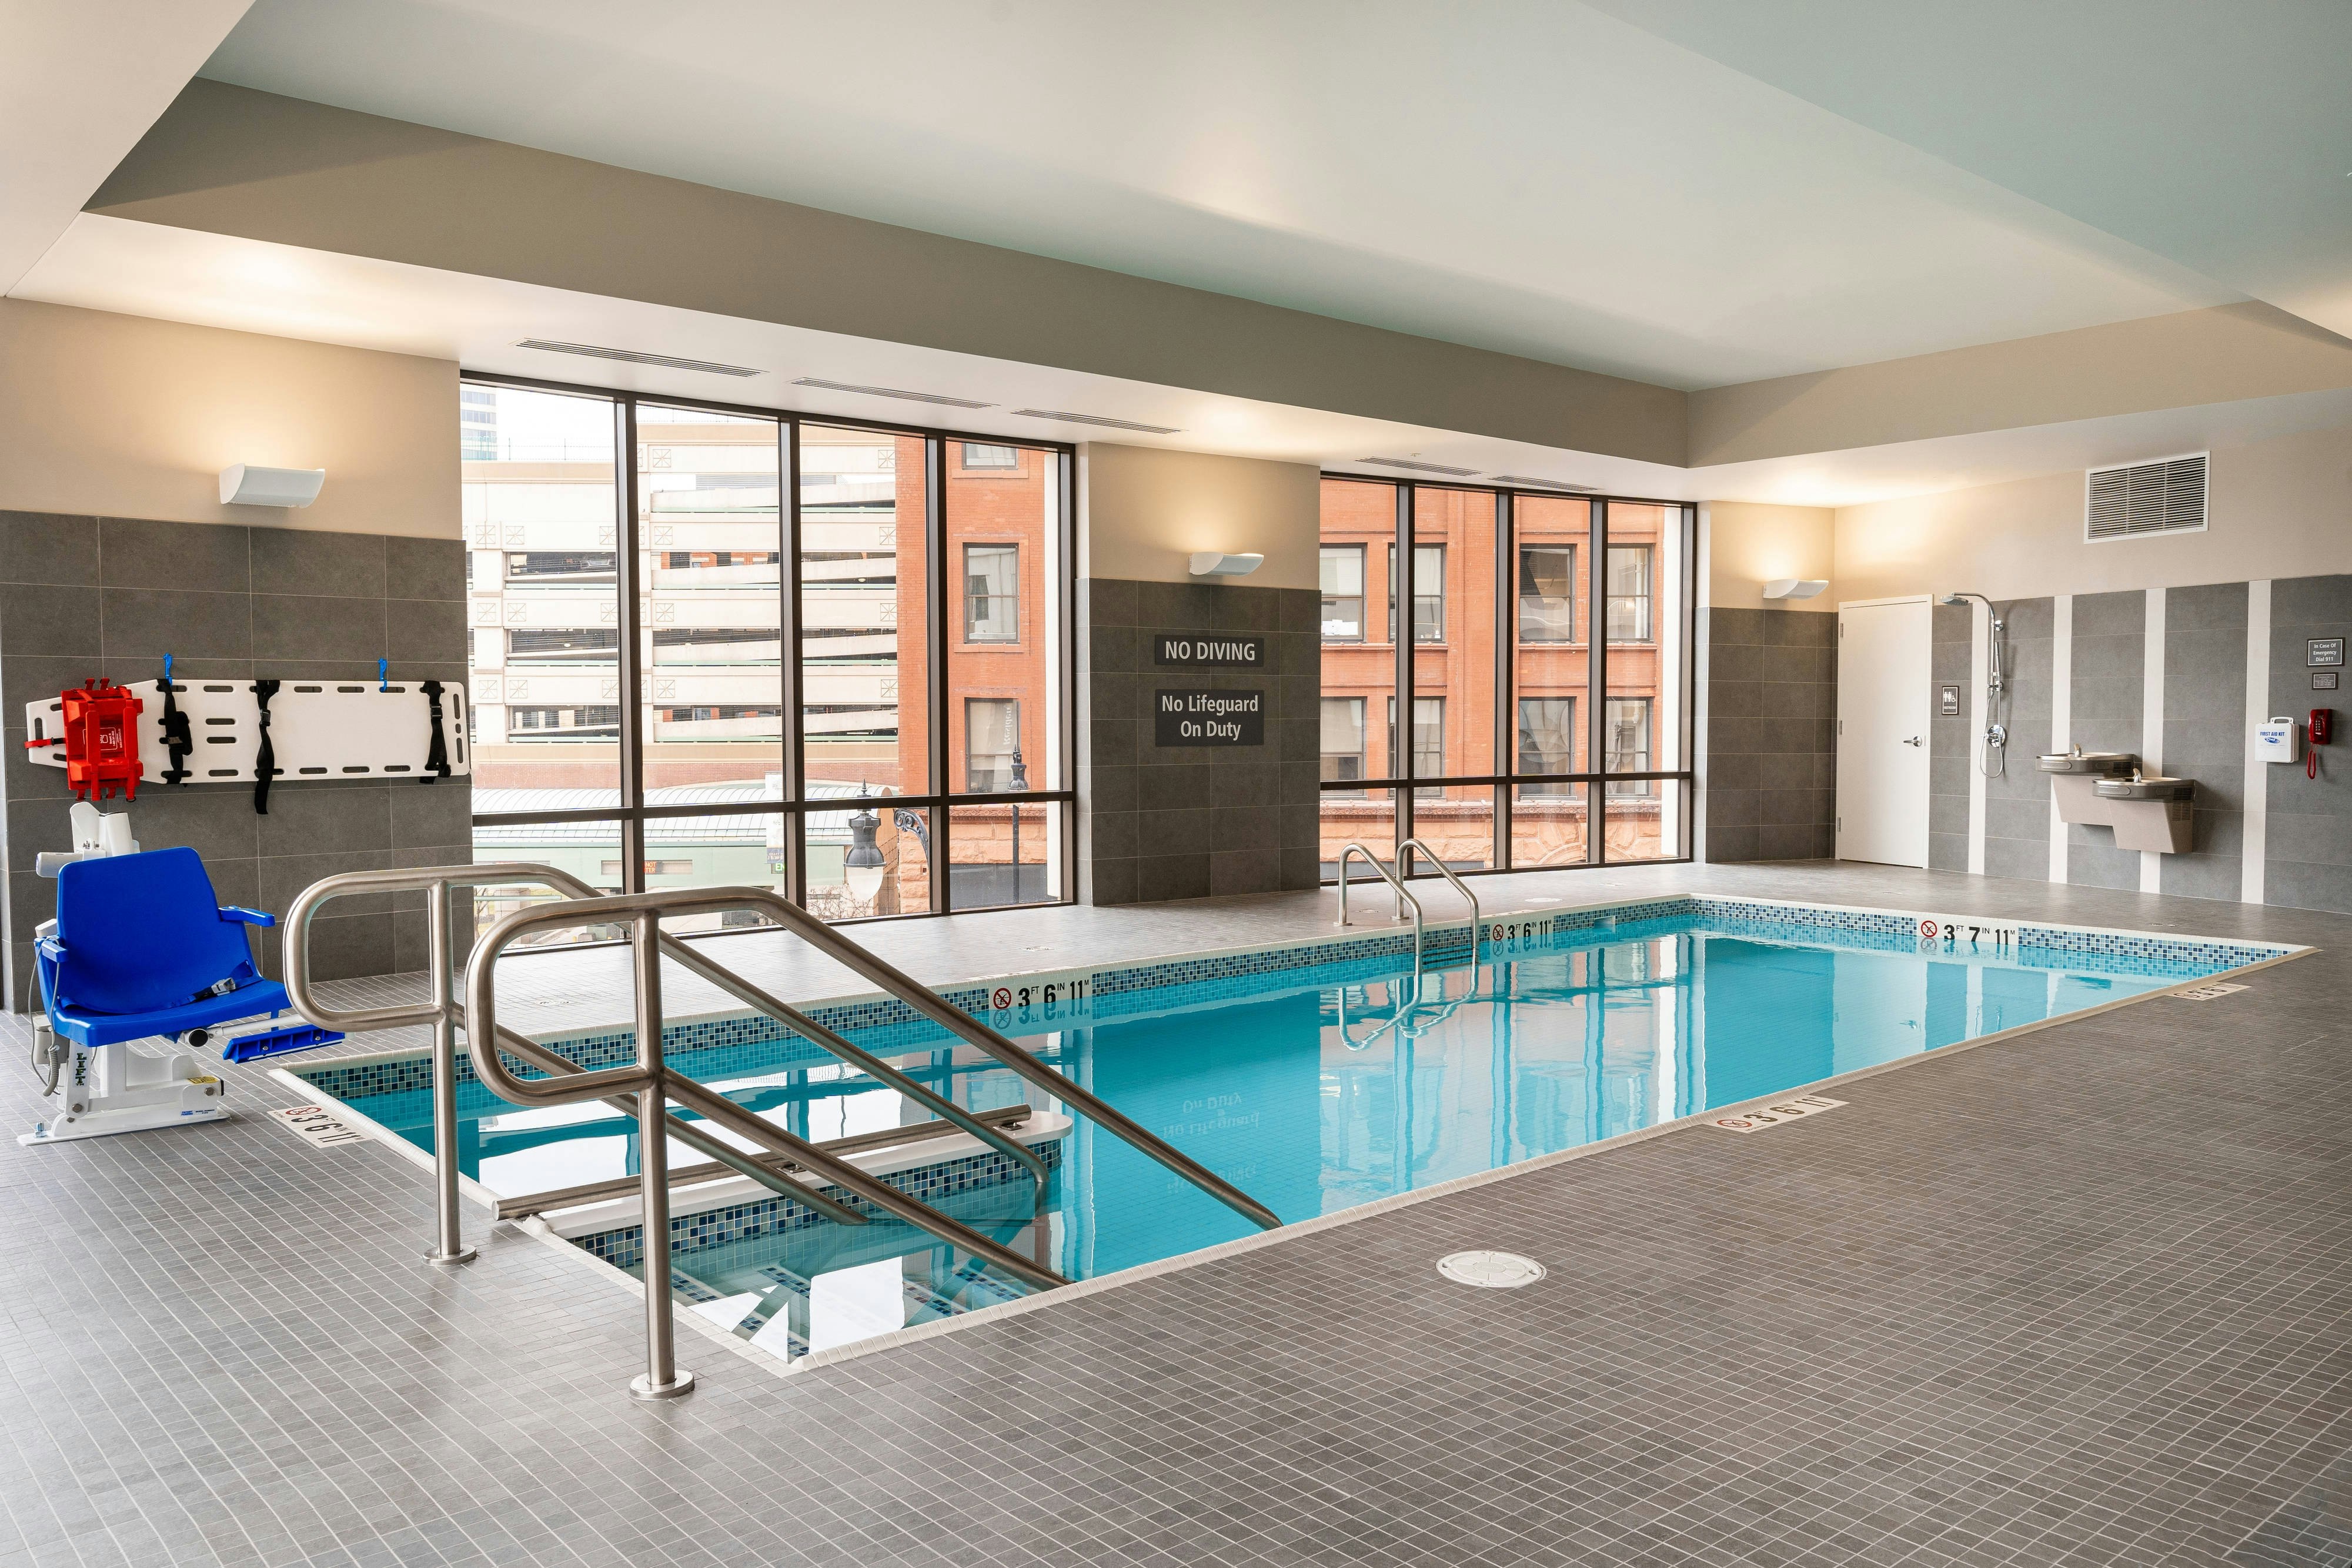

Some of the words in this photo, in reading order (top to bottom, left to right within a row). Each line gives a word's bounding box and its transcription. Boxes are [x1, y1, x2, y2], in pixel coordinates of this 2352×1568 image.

[1165, 641, 1191, 660] NO
[1197, 641, 1255, 661] DIVING
[1162, 695, 1183, 712] No
[1188, 694, 1258, 716] Lifeguard
[1180, 720, 1201, 737] On
[1207, 721, 1241, 741] Duty
[775, 862, 785, 871] EN
[1508, 924, 1515, 940] 3
[1524, 922, 1531, 938] 6
[1944, 924, 1955, 940] 3
[1969, 926, 1980, 942] 7
[1018, 987, 1030, 1007] 3
[1031, 986, 1040, 995] FT
[1044, 984, 1056, 1004] 6
[1057, 982, 1065, 991] IN
[75, 1052, 88, 1084] LIFT
[1743, 1114, 1778, 1122] 3
[1769, 1106, 1805, 1115] 6
[304, 1123, 343, 1132] 6
